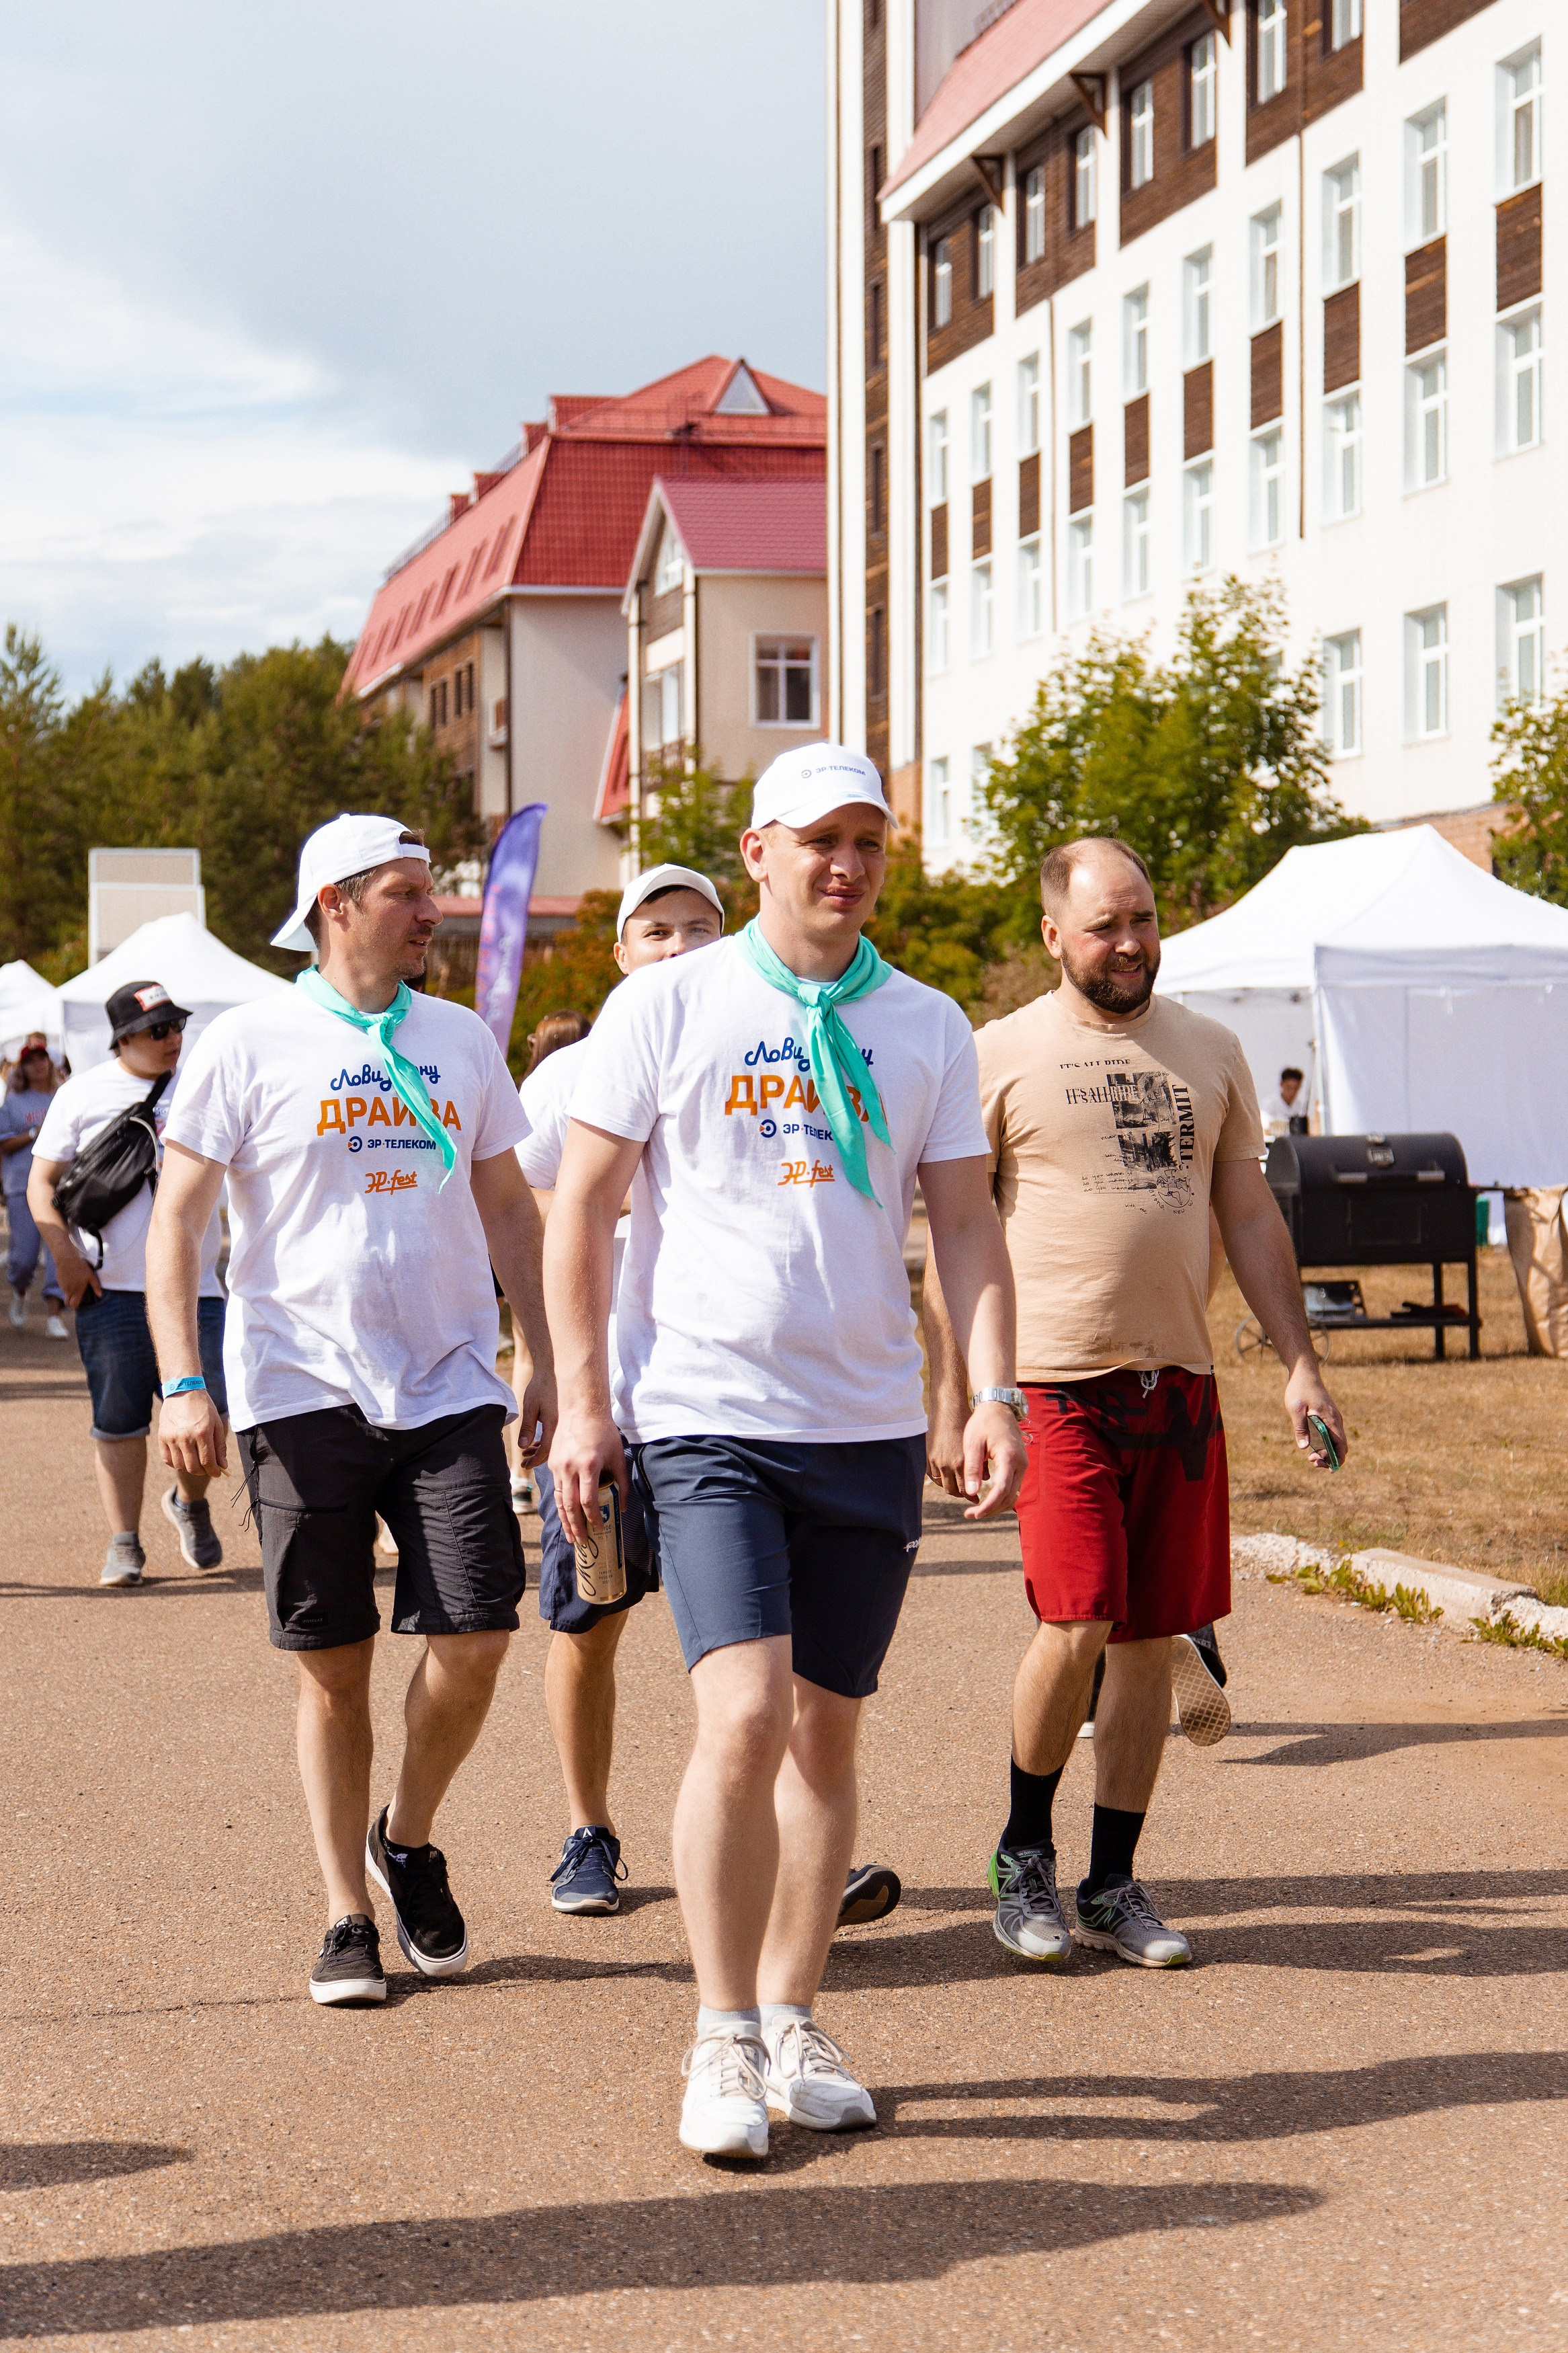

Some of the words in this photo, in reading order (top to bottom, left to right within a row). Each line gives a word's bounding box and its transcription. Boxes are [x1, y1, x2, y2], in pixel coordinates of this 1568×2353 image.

[744, 1037, 804, 1066] Лови
[331, 1064, 383, 1090] Лови
[1171, 1084, 1195, 1164] TERMIT
